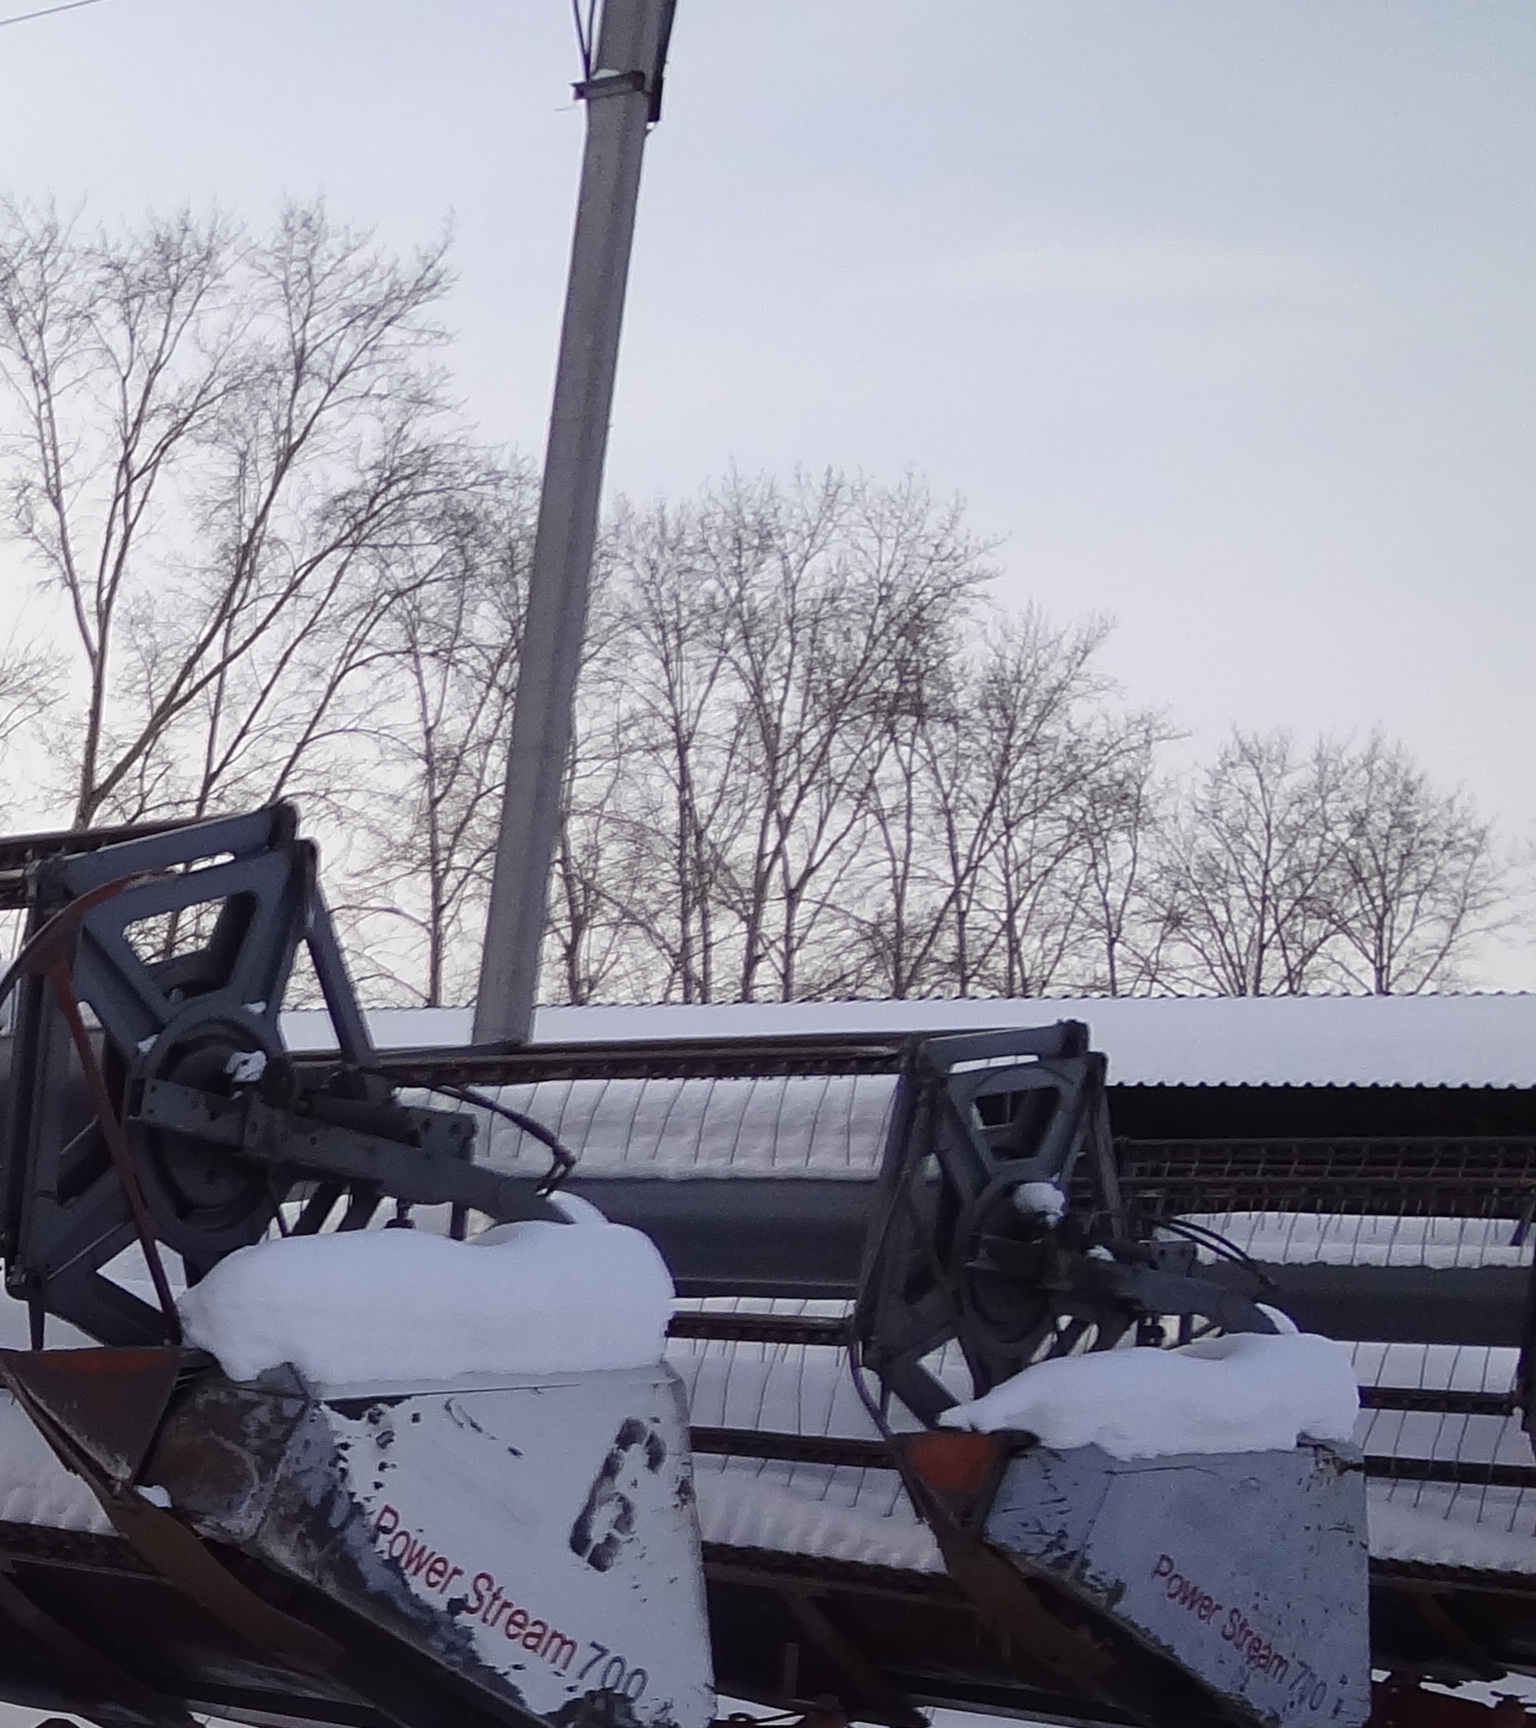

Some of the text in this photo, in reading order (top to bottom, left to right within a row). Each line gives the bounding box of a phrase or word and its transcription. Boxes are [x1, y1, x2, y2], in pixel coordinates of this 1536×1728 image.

[375, 1503, 650, 1702] Power Stream 700
[1151, 1553, 1224, 1626] Power
[1220, 1607, 1290, 1685] Stream
